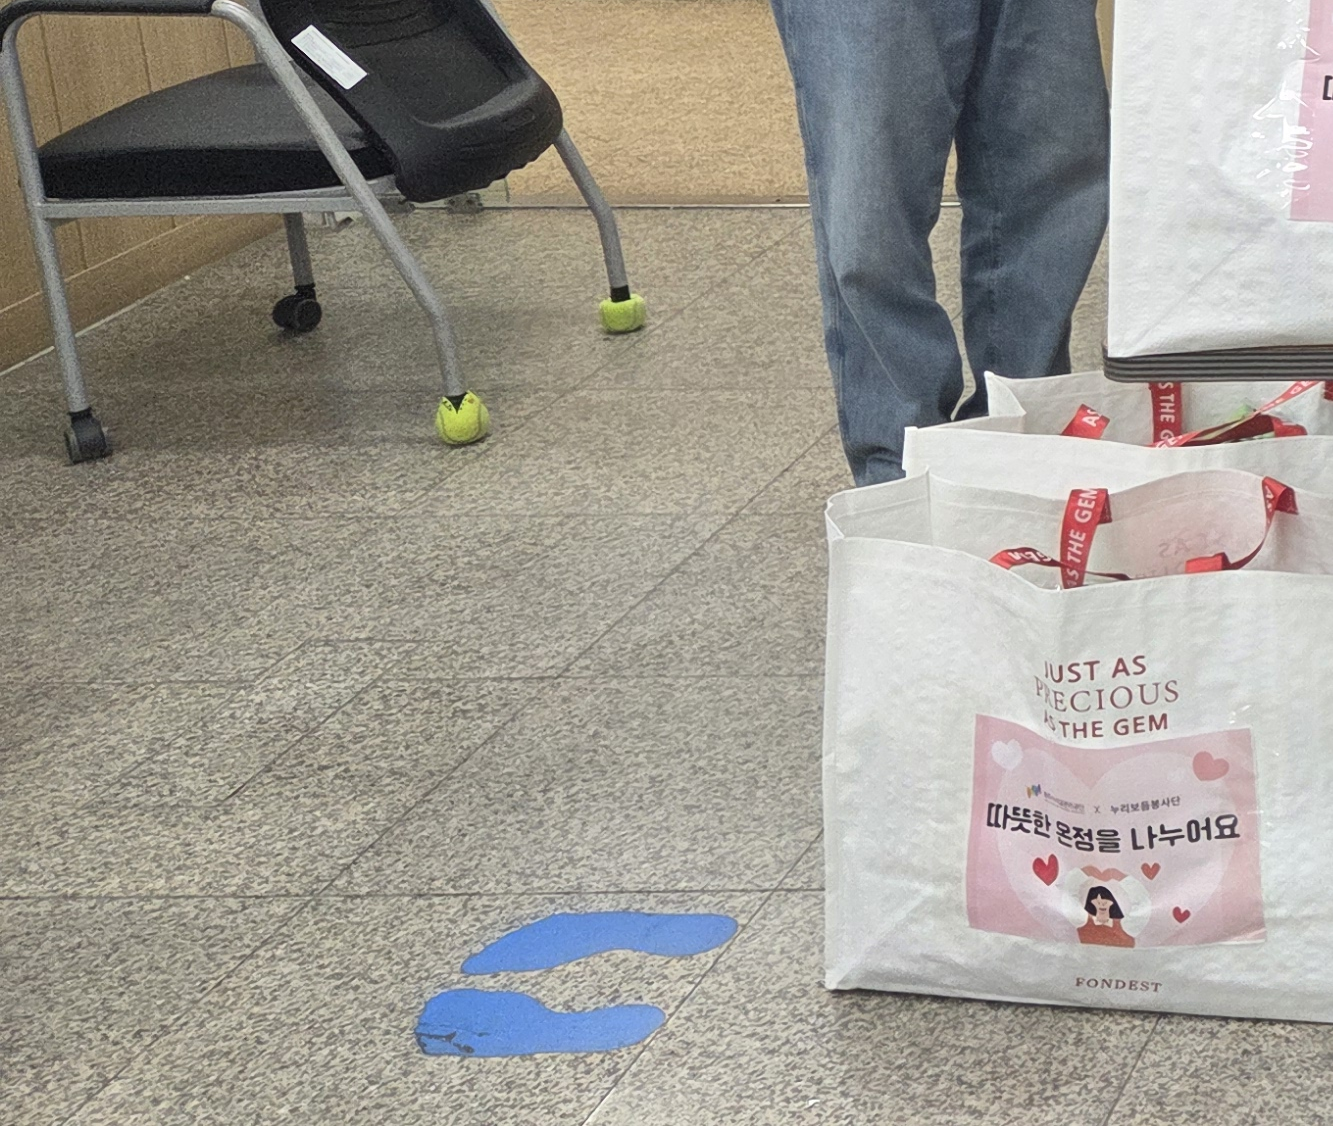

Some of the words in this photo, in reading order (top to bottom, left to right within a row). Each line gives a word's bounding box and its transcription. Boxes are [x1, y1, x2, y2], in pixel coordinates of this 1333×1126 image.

[1159, 394, 1175, 424] THE
[1066, 528, 1087, 565] THE
[1044, 660, 1101, 684] JUST
[1111, 655, 1147, 678] AS
[1033, 675, 1180, 713] PRECIOUS
[1058, 720, 1105, 739] THE
[1112, 712, 1169, 736] GEM
[986, 802, 1052, 839] 따뜻한
[1055, 819, 1121, 853] 온정을
[1130, 813, 1241, 851] 나누어요
[1075, 977, 1163, 993] FONDEST
